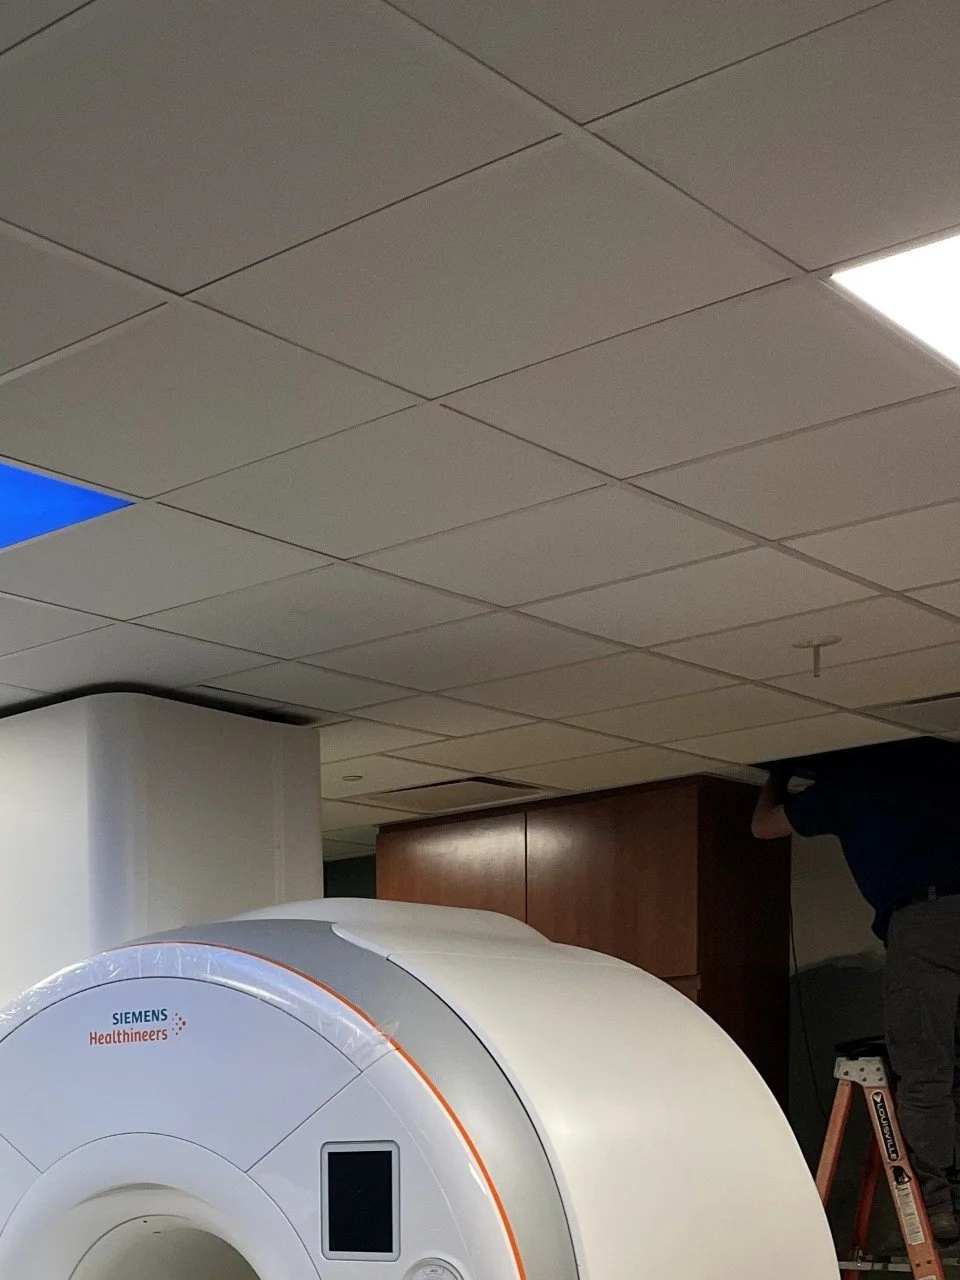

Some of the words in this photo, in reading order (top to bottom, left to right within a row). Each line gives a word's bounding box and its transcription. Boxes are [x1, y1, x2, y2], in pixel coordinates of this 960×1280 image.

[112, 1008, 168, 1025] SIEMENS
[89, 1027, 168, 1045] Healthineers
[876, 1102, 897, 1160] LOUISVILLE
